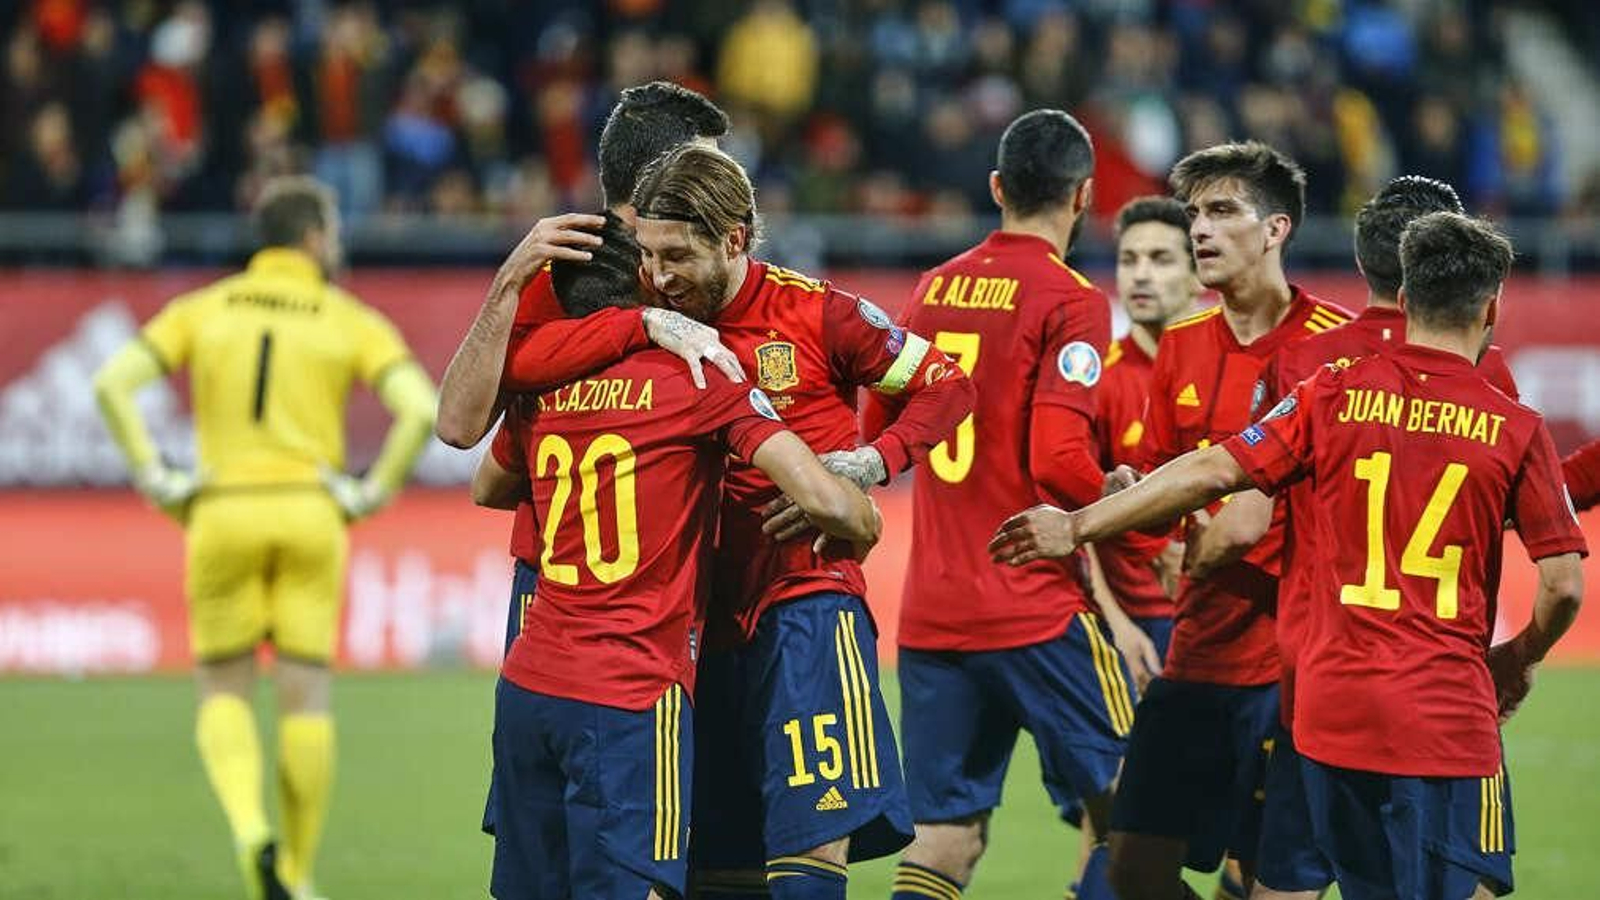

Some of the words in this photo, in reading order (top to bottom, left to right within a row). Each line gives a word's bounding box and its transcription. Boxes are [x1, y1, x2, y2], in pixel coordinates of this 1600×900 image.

[942, 274, 1019, 311] ALBIOL
[254, 331, 272, 422] 1
[554, 378, 654, 412] CAZORLA
[1338, 389, 1404, 428] JUAN
[1405, 398, 1506, 447] BERNAT
[536, 433, 640, 586] 20
[1340, 451, 1469, 619] 14
[783, 713, 843, 787] 15
